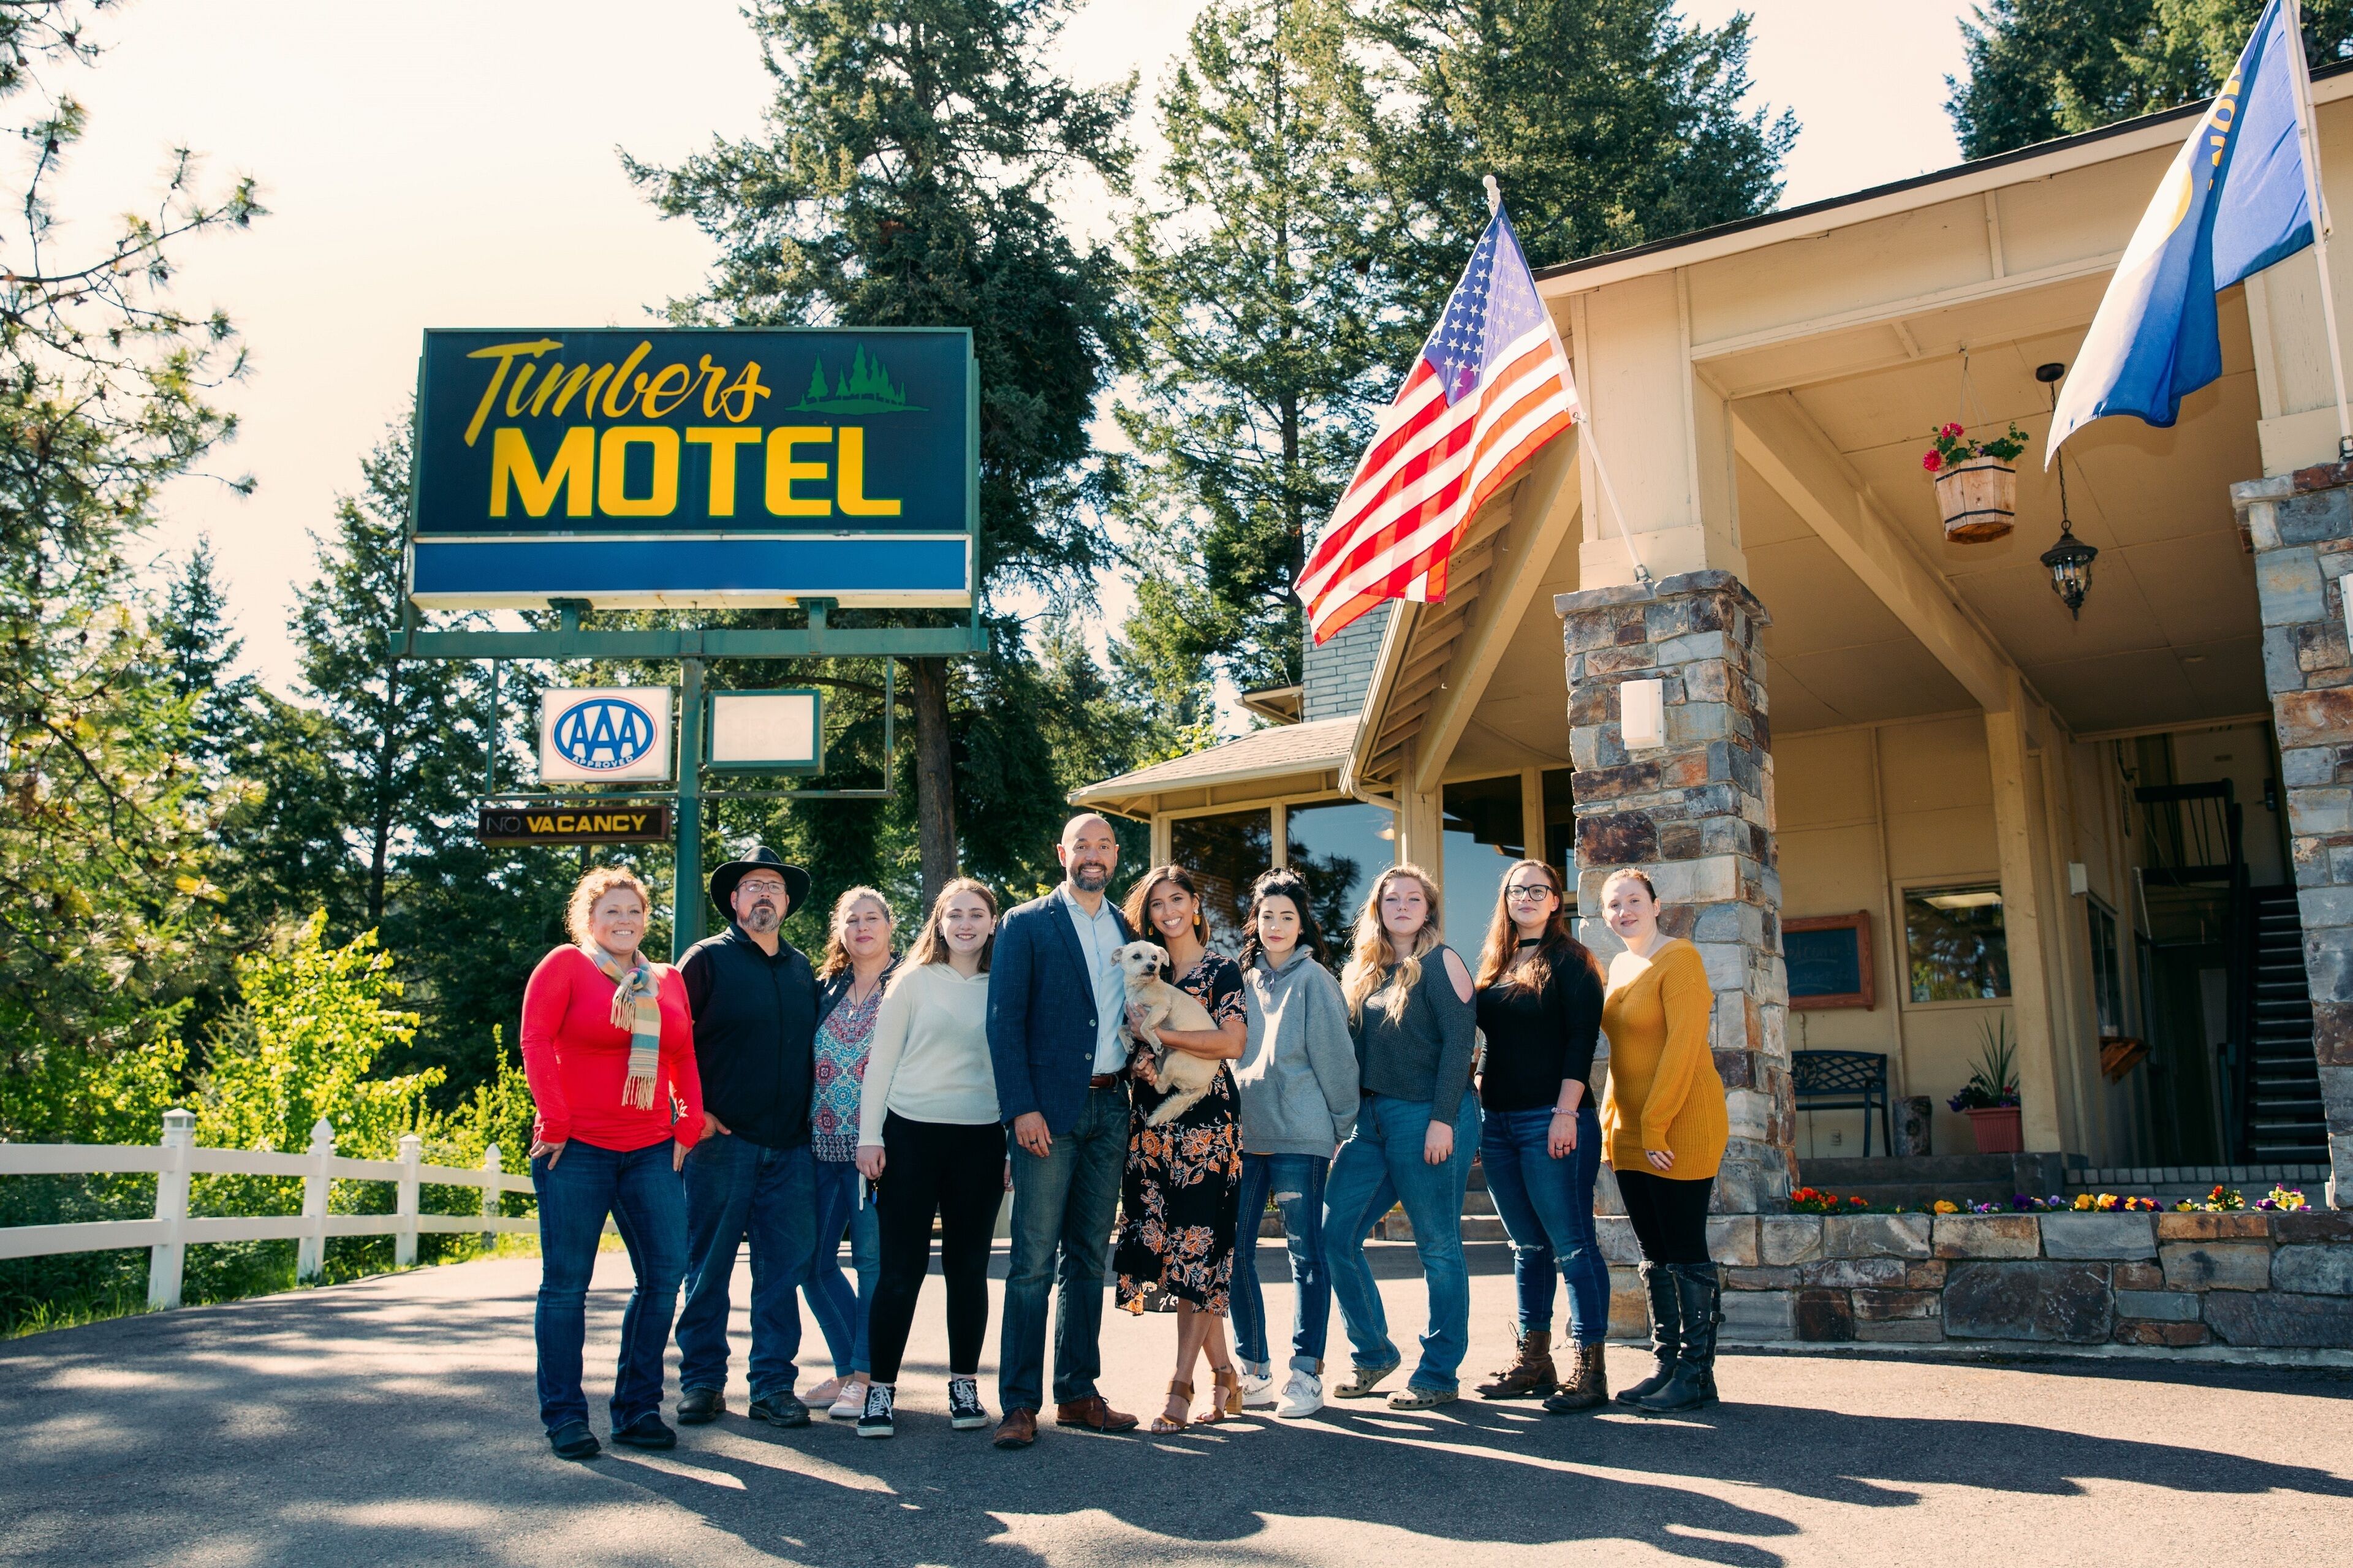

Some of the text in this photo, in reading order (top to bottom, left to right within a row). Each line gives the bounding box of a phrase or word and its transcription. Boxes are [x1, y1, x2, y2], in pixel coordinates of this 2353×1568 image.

[464, 338, 772, 448] Timbers
[489, 425, 903, 518] MOTEL
[565, 702, 640, 763] AAA
[571, 755, 634, 769] APPROVED
[486, 814, 647, 833] NO VACANCY
